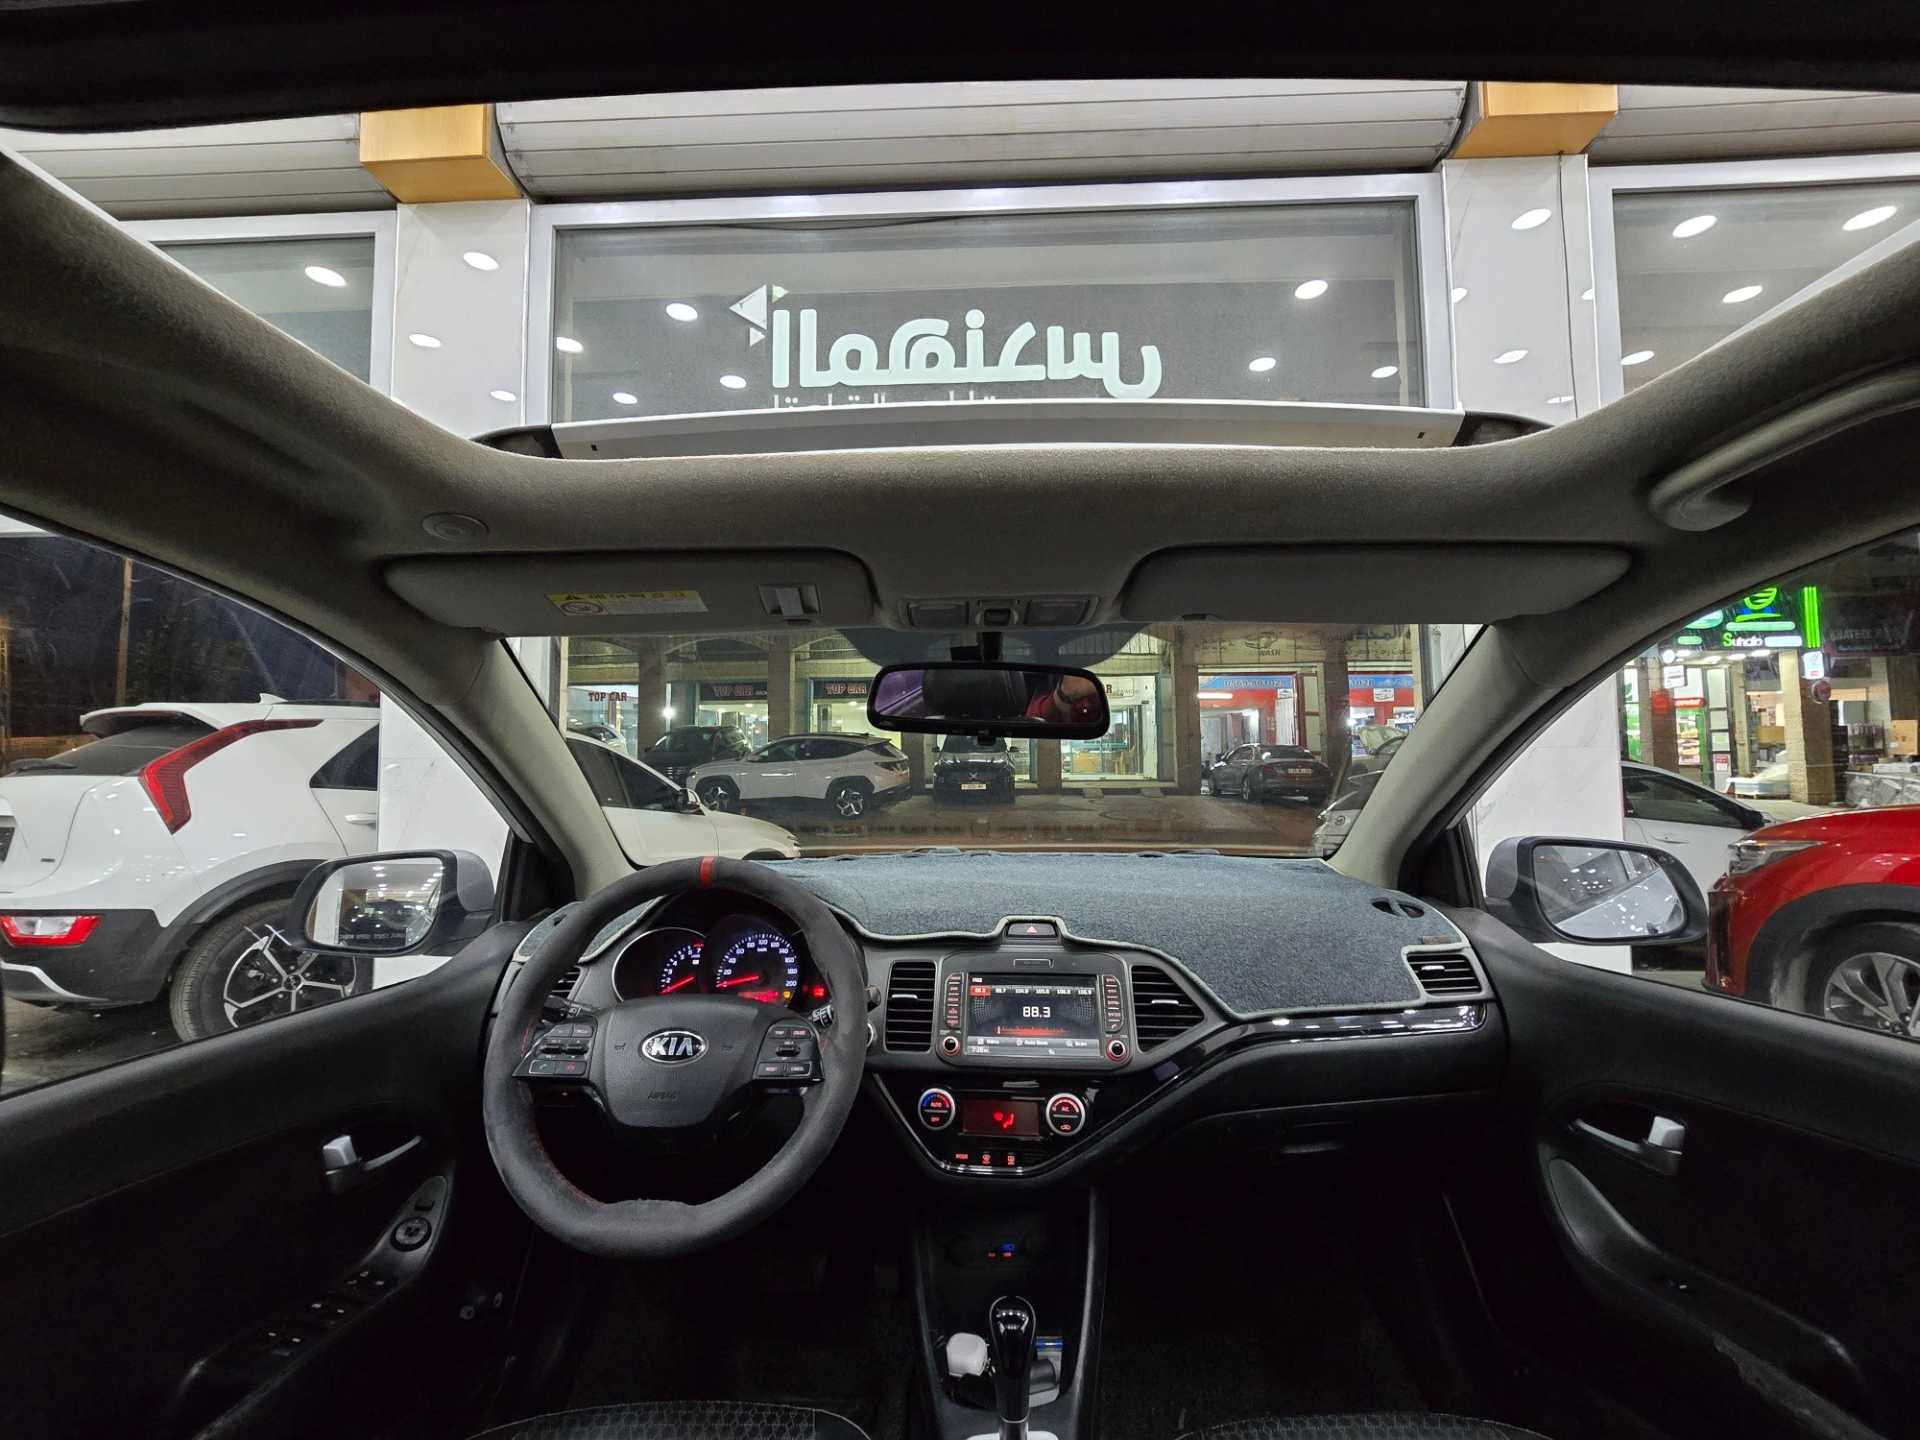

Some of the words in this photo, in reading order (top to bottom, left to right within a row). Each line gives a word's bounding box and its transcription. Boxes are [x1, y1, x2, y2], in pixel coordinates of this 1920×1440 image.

[588, 691, 607, 701] TOP
[608, 691, 627, 702] CAR
[723, 968, 732, 976] 20
[785, 979, 797, 987] 200
[1023, 1006, 1051, 1018] 88.3
[651, 1037, 695, 1056] KIA
